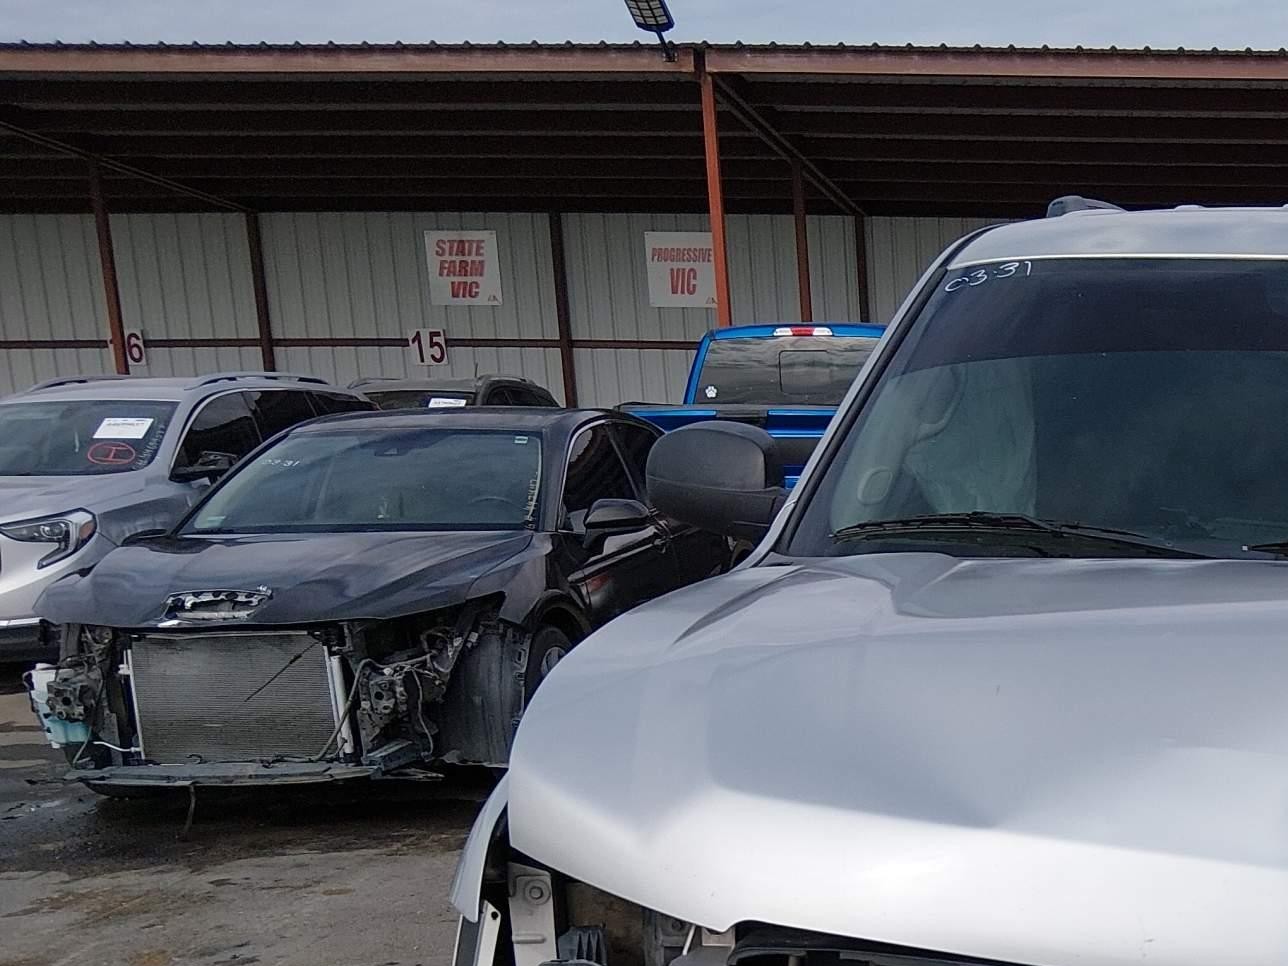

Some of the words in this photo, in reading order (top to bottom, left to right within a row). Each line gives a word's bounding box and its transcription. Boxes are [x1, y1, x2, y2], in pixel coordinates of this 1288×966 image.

[435, 239, 485, 257] STATE
[651, 247, 713, 263] PROGRESSIVE
[438, 259, 485, 277] FARM
[450, 280, 481, 299] VIC
[670, 267, 698, 296] VIC
[410, 330, 446, 364] 15
